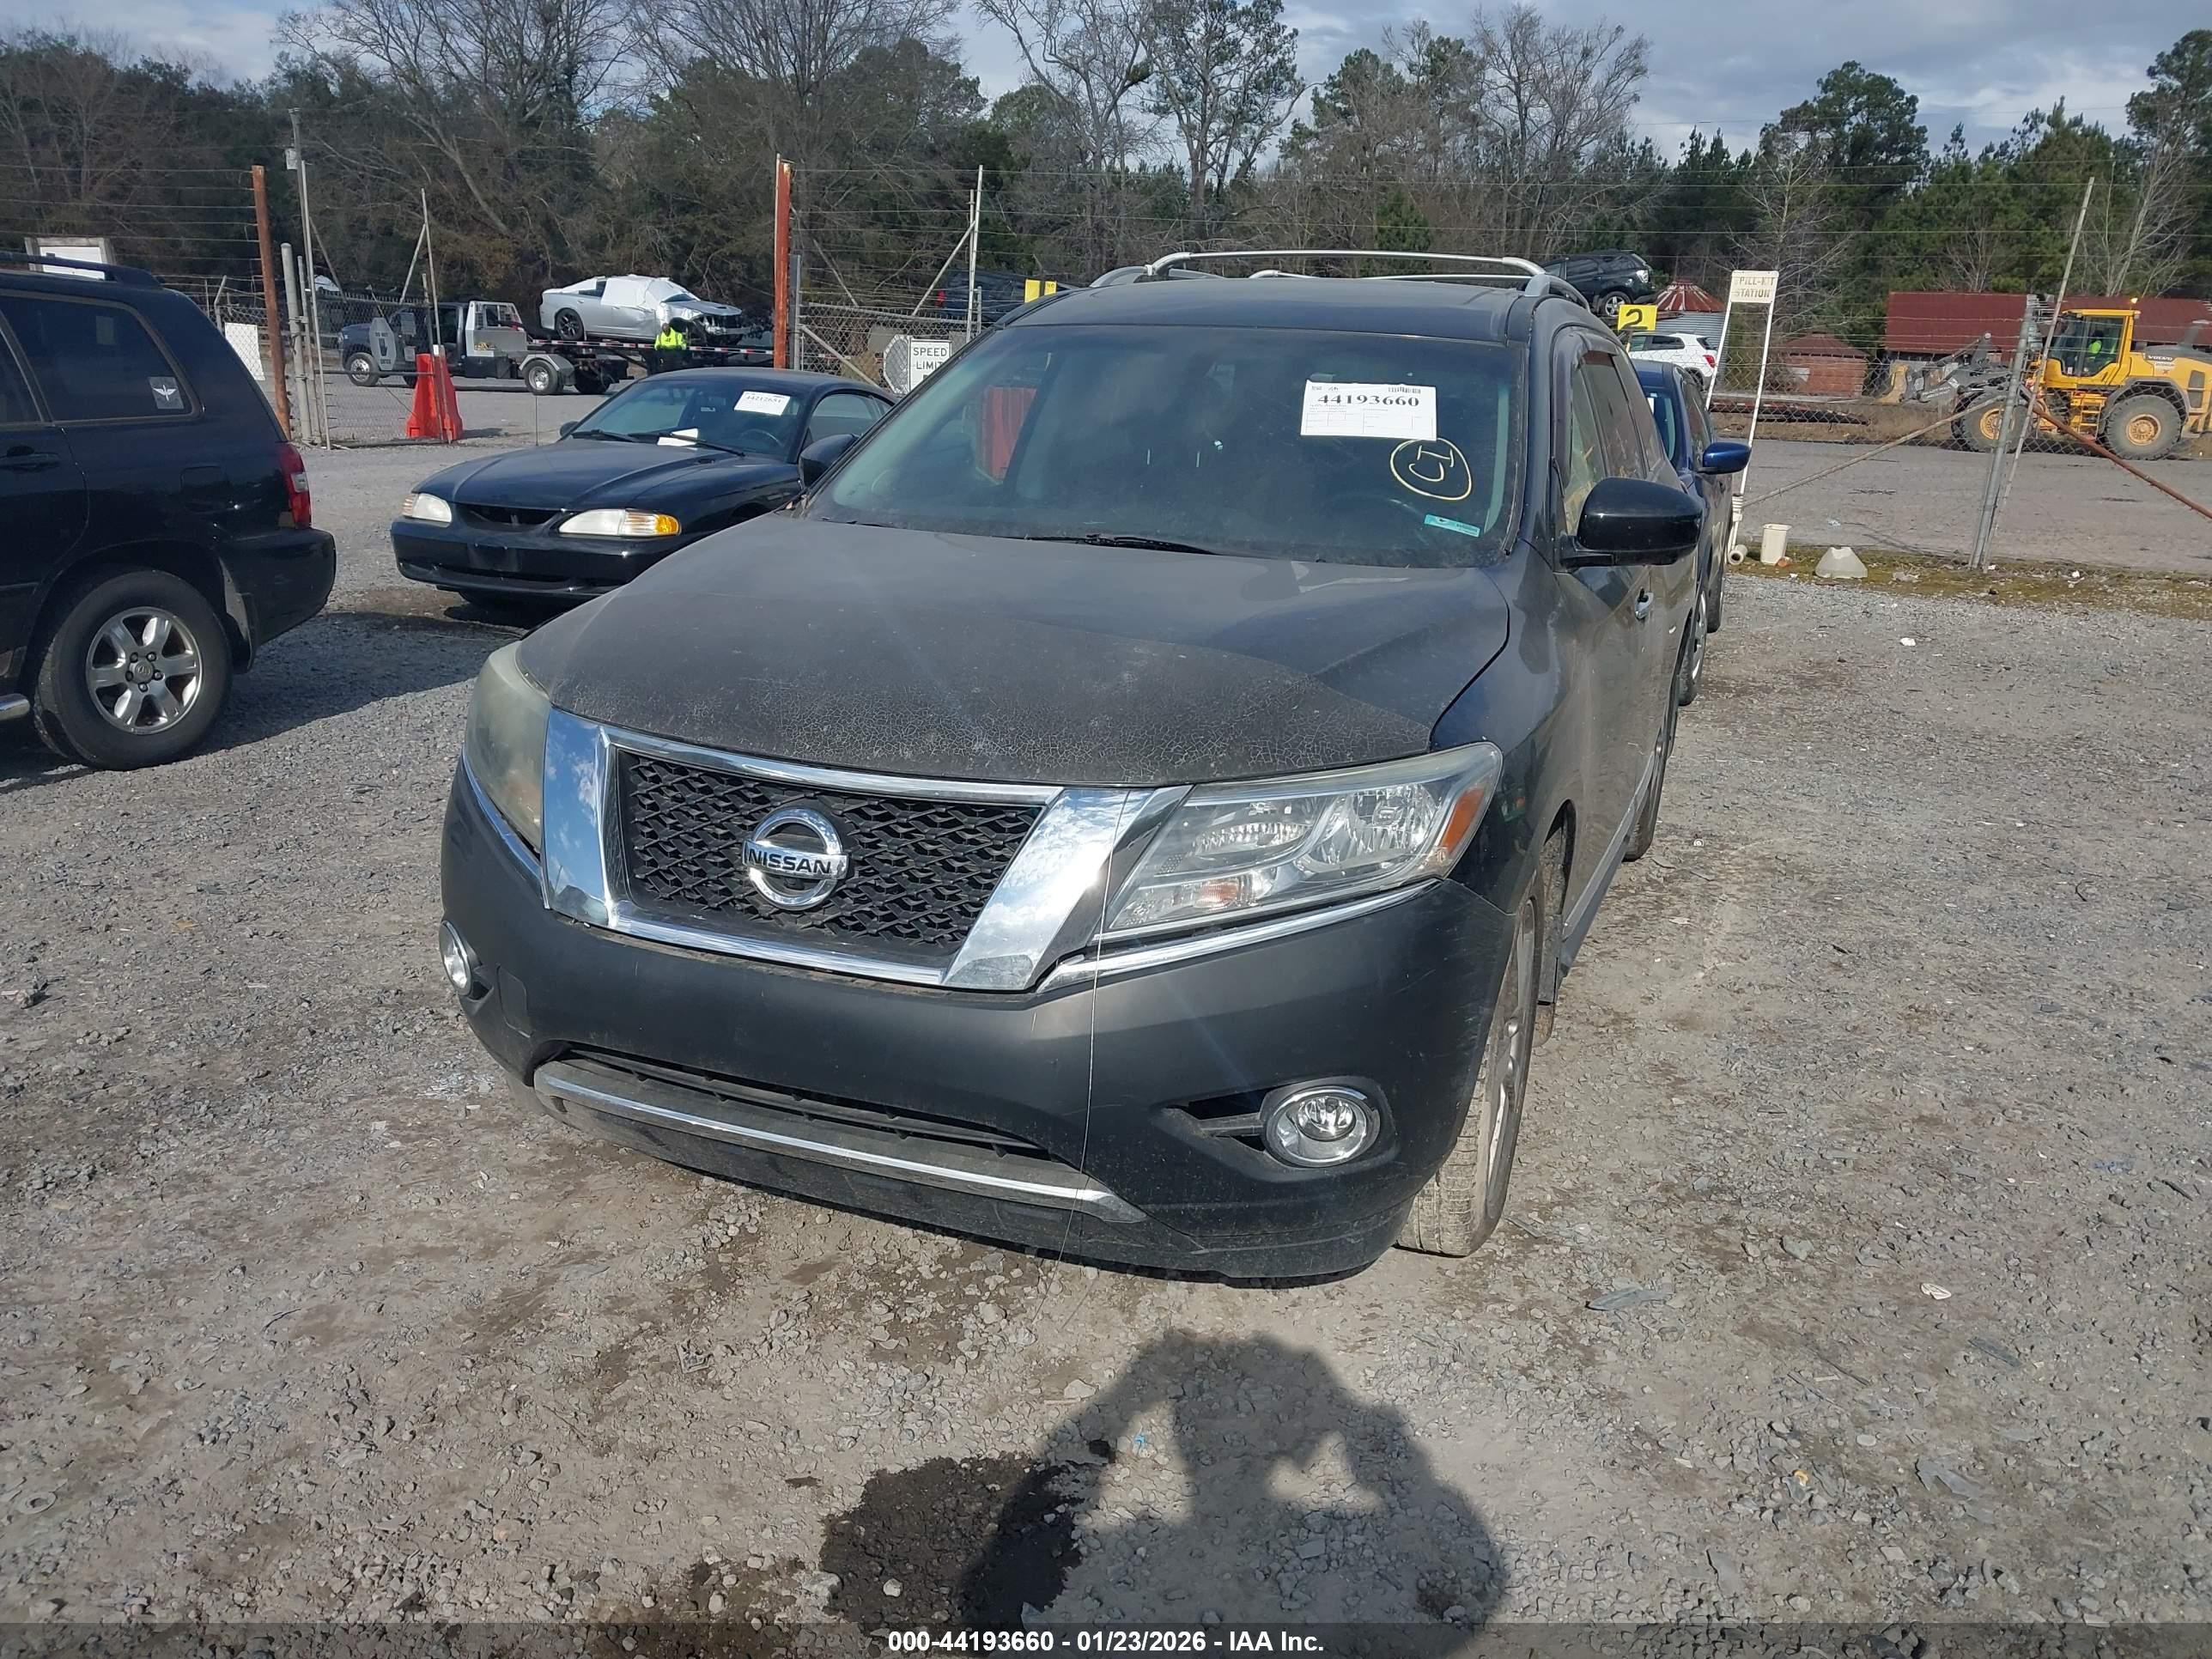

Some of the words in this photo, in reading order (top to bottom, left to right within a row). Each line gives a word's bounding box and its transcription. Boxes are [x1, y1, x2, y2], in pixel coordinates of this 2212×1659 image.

[1620, 308, 1649, 330] 2
[913, 347, 947, 357] SPEED
[1317, 394, 1419, 407] 44193660
[748, 848, 831, 874] NISSAN
